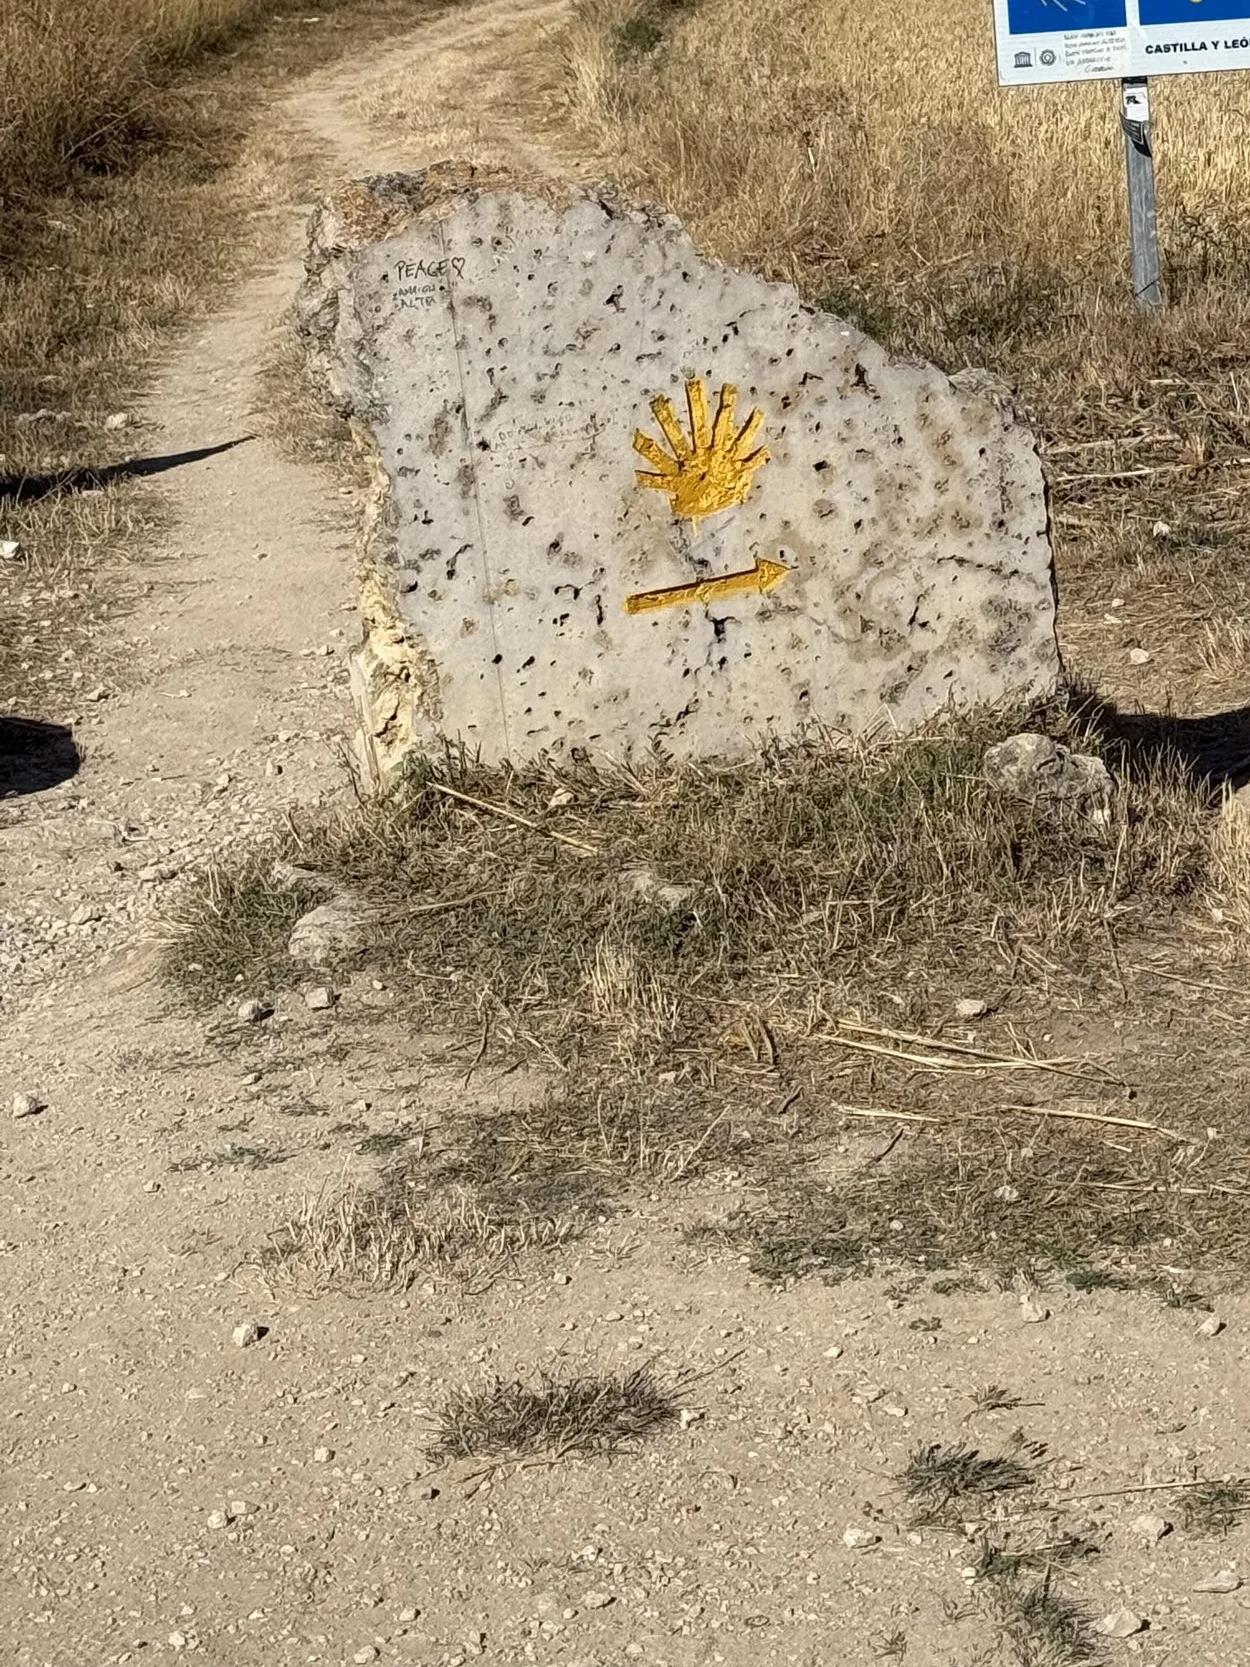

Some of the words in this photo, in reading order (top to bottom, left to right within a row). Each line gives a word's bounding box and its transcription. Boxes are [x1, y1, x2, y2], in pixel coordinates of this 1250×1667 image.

[1145, 41, 1208, 54] CASTILLA
[1211, 40, 1220, 50] Y
[393, 258, 450, 282] PEACE
